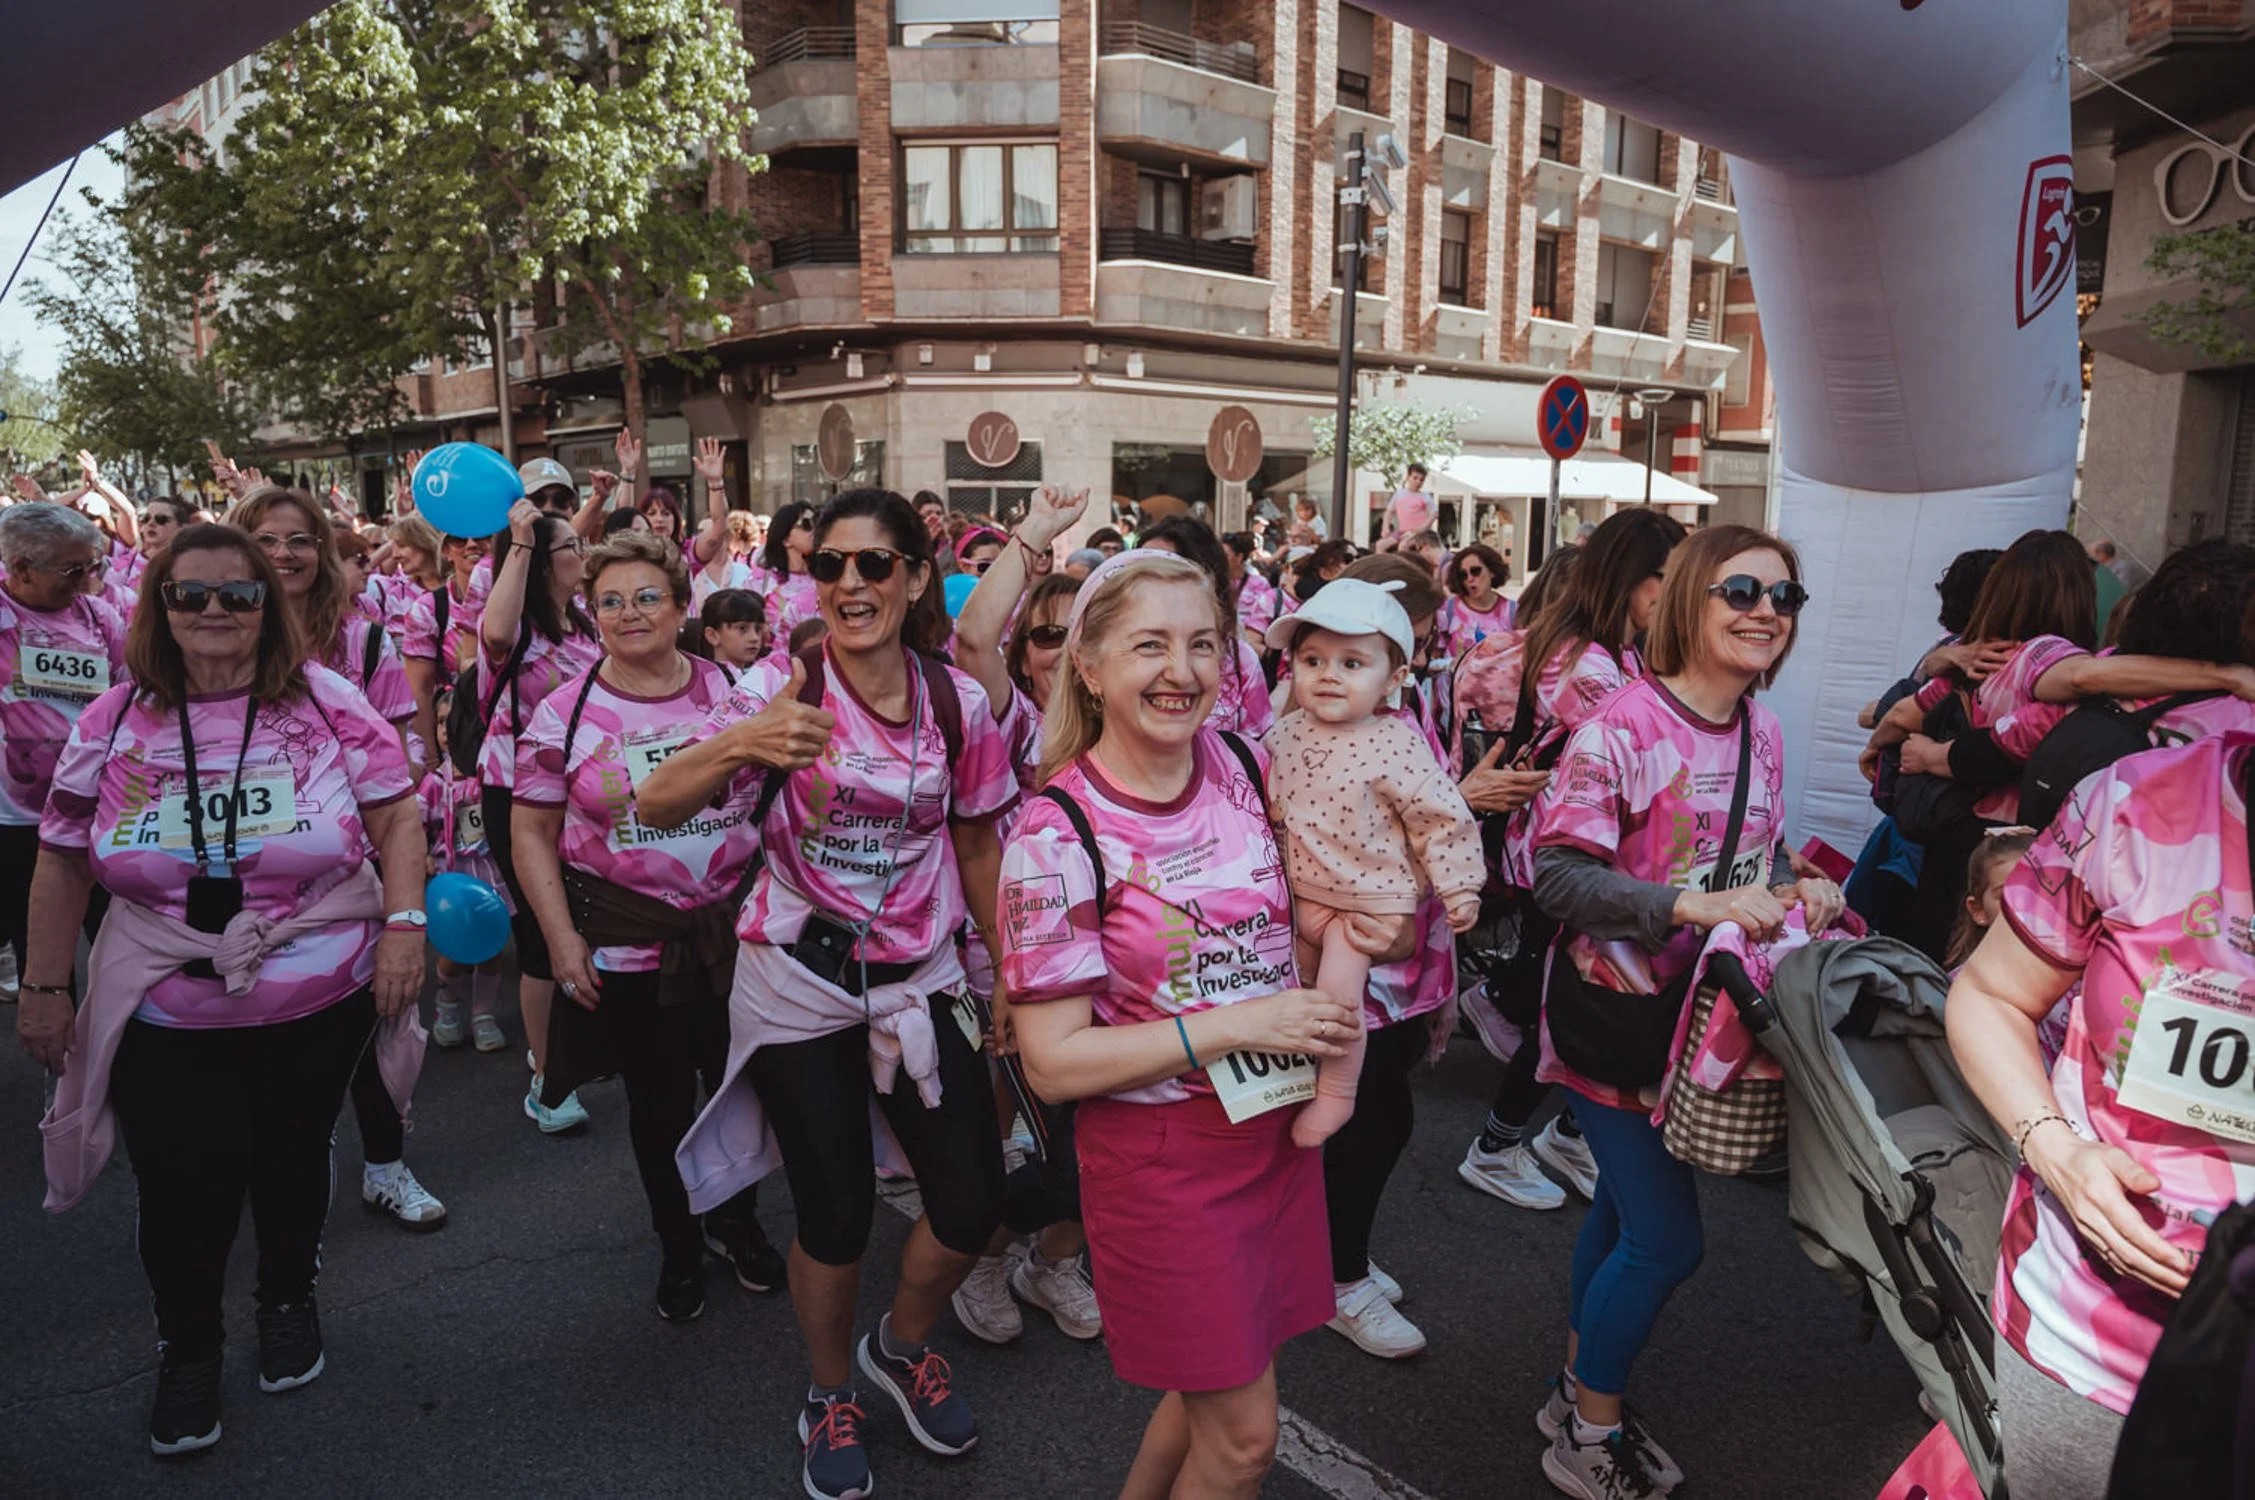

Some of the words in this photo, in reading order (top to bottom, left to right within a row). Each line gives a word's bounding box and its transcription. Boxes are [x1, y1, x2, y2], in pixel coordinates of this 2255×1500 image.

[541, 462, 560, 476] A
[35, 651, 97, 679] 6436
[831, 784, 856, 805] XI
[636, 810, 748, 843] Investigació
[828, 809, 904, 829] Carrera
[1695, 811, 1711, 831] XI
[823, 834, 859, 853] por
[863, 835, 880, 853] la
[1193, 911, 1269, 938] Crera
[1156, 903, 1198, 1001] muje
[1196, 949, 1234, 974] por
[1238, 945, 1260, 965] la
[2170, 986, 2253, 1012] nvestigación
[2161, 1016, 2250, 1089] 10
